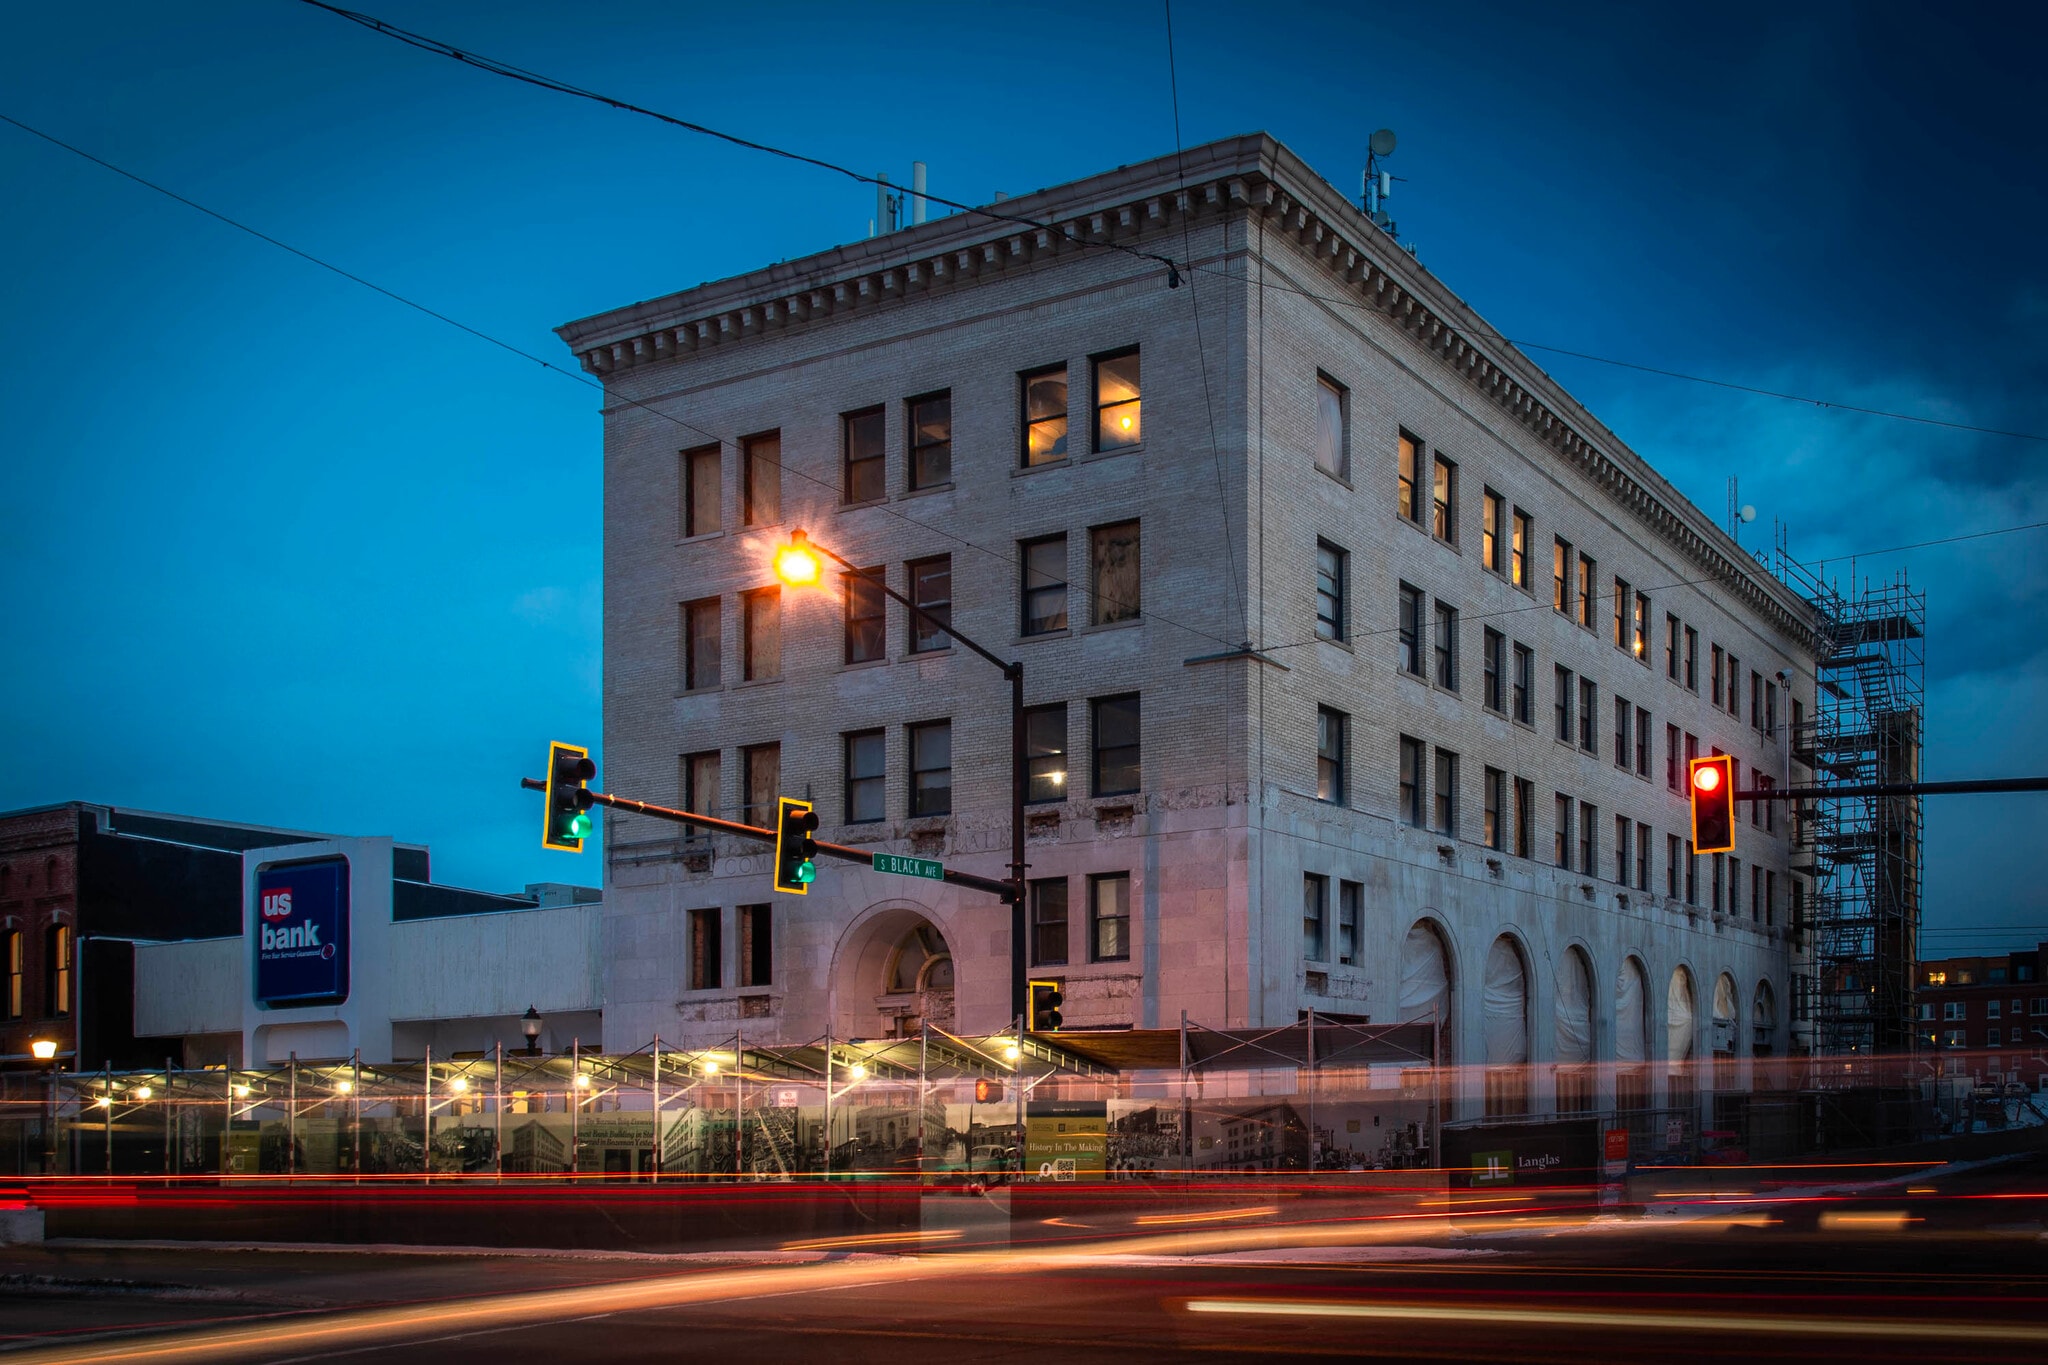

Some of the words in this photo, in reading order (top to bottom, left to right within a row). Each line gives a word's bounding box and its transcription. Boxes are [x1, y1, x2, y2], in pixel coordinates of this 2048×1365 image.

[880, 859, 886, 870] S
[891, 857, 920, 875] BLACK
[925, 866, 936, 877] AVE
[261, 919, 321, 951] bank
[1029, 1142, 1053, 1153] History
[1055, 1142, 1062, 1151] In
[1063, 1142, 1077, 1151] The
[1078, 1142, 1104, 1153] Making
[1518, 1154, 1560, 1169] Langlas
